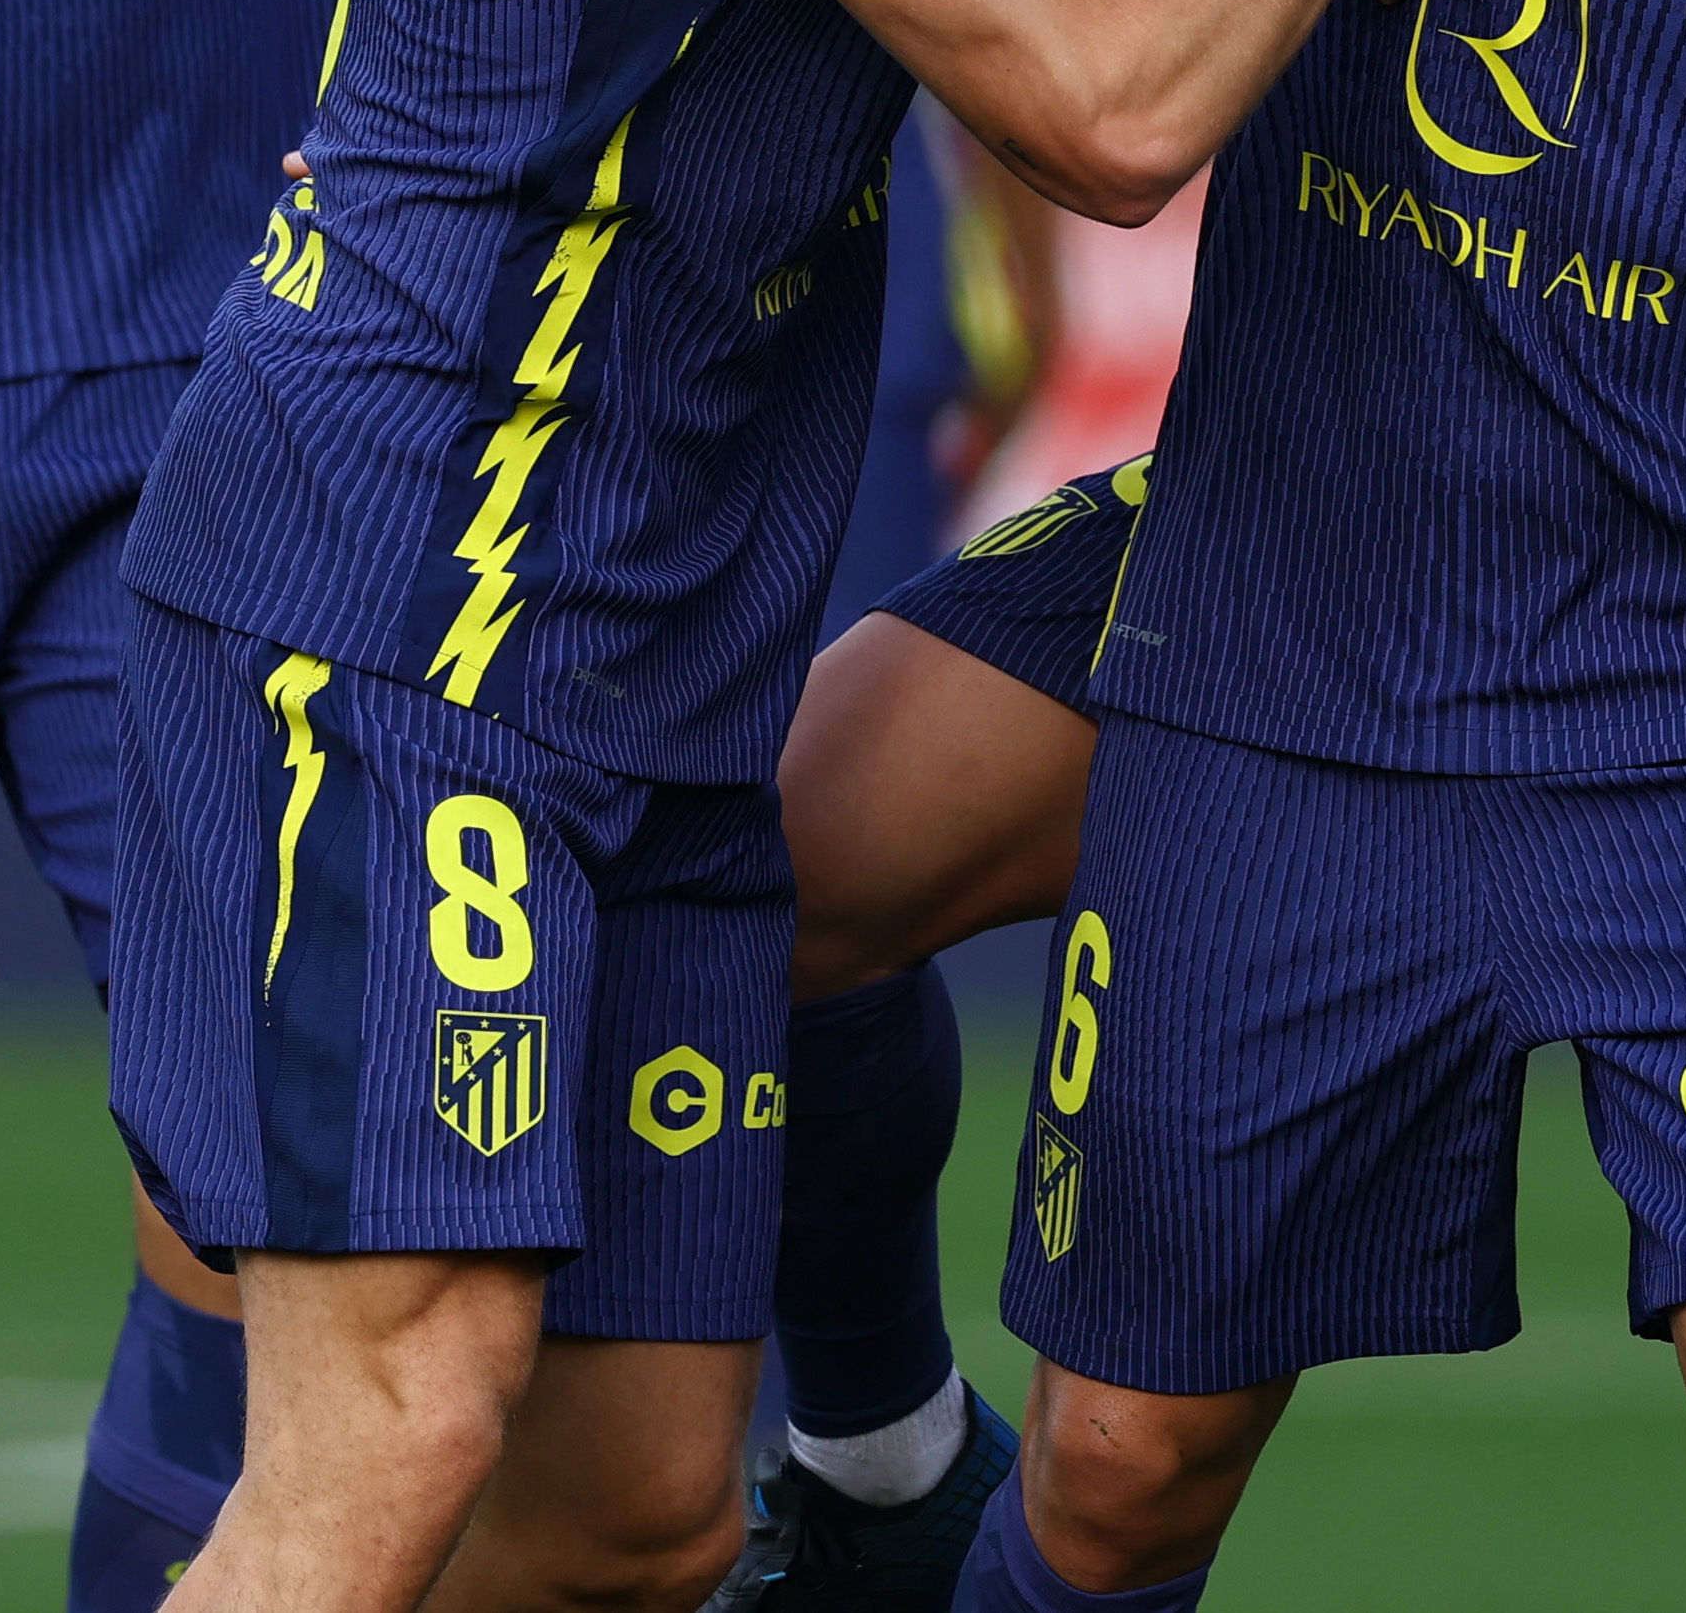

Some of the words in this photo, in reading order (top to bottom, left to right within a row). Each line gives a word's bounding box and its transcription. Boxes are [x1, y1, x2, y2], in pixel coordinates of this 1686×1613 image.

[1297, 151, 1528, 289] RIYADH
[1542, 251, 1676, 325] AIR
[425, 793, 534, 993] 8
[1049, 909, 1112, 1116] 6
